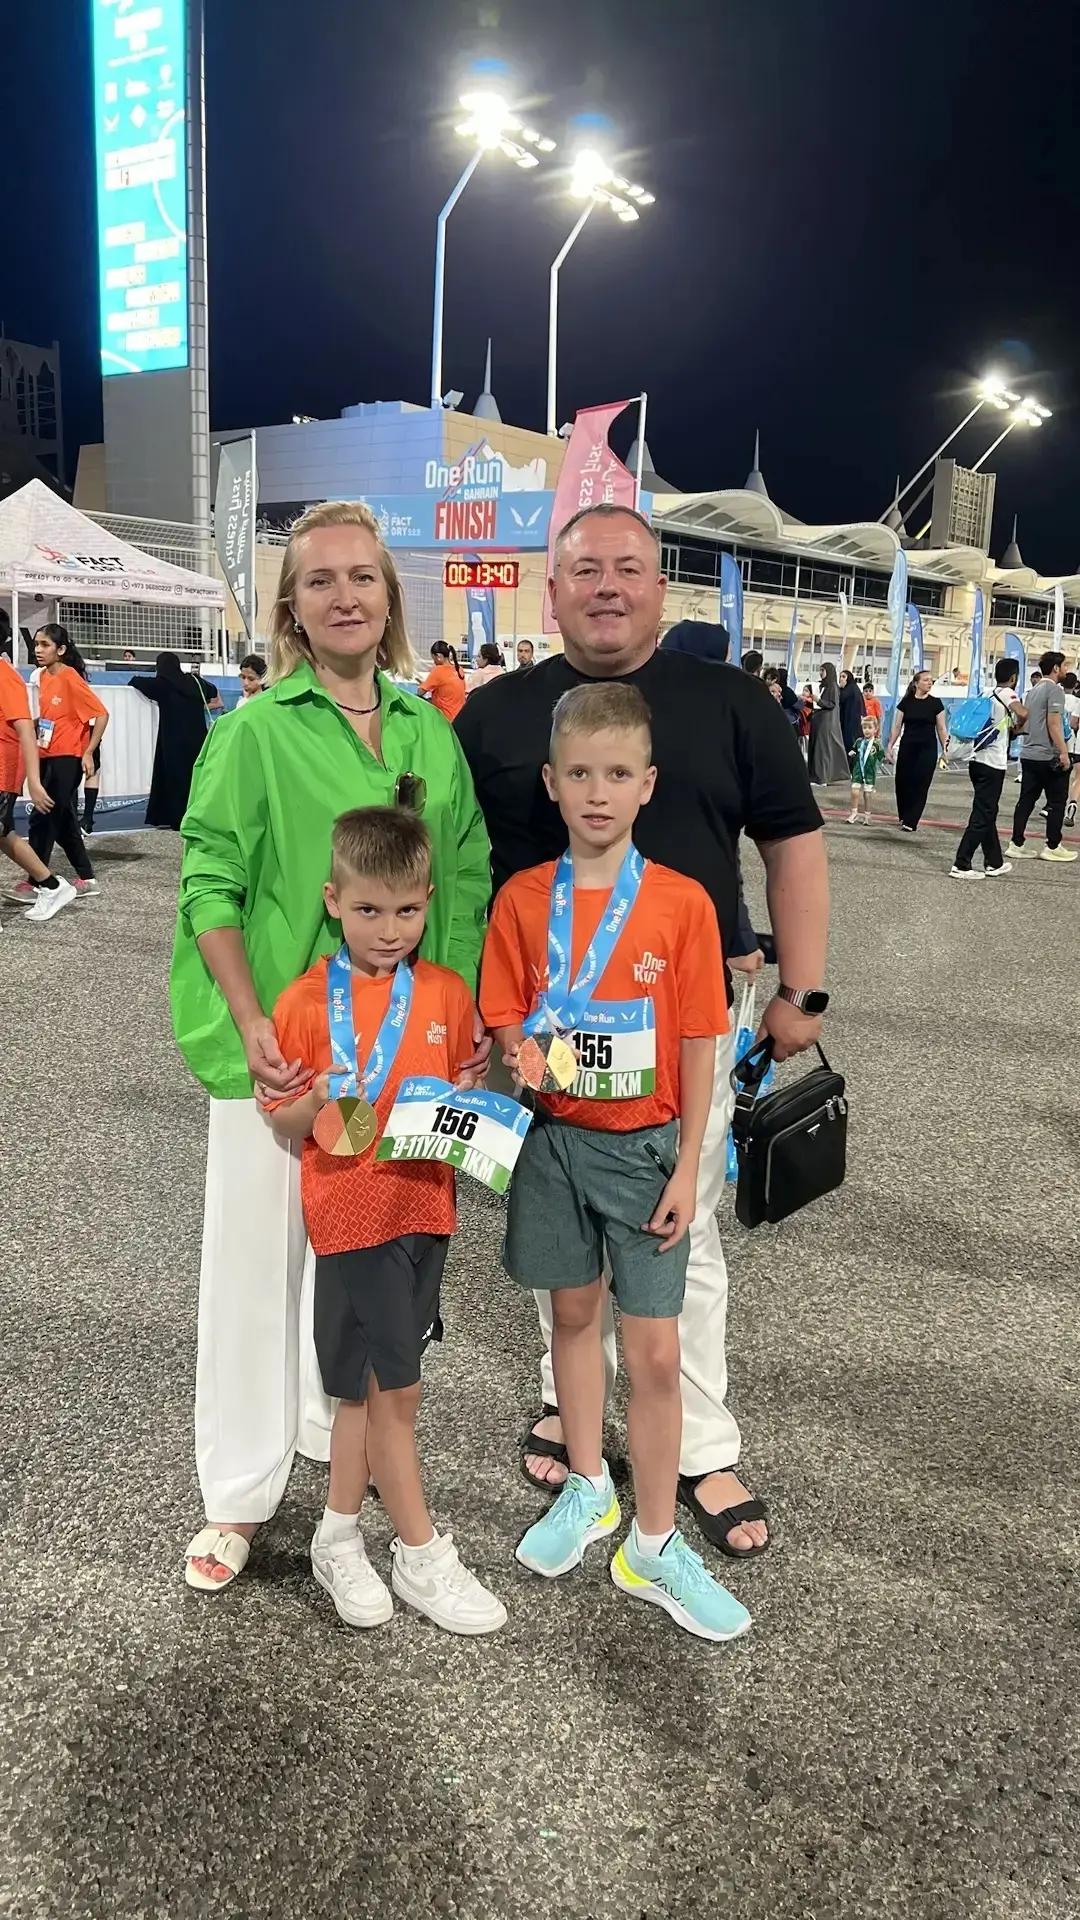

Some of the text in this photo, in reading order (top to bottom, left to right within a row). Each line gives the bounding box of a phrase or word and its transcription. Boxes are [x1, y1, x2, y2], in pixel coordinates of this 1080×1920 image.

[464, 486, 499, 500] BAHRAIN
[391, 516, 412, 526] FACT
[434, 501, 497, 540] FINISH
[75, 556, 124, 566] FACT
[88, 578, 116, 587] DISTANCE
[448, 564, 514, 585] 00:13:40
[642, 951, 667, 972] One
[633, 963, 657, 984] Run
[430, 1021, 447, 1035] One
[572, 1031, 612, 1070] 155
[608, 1071, 642, 1097] 1KM
[431, 1105, 479, 1141] 156
[460, 1146, 497, 1183] 1KM
